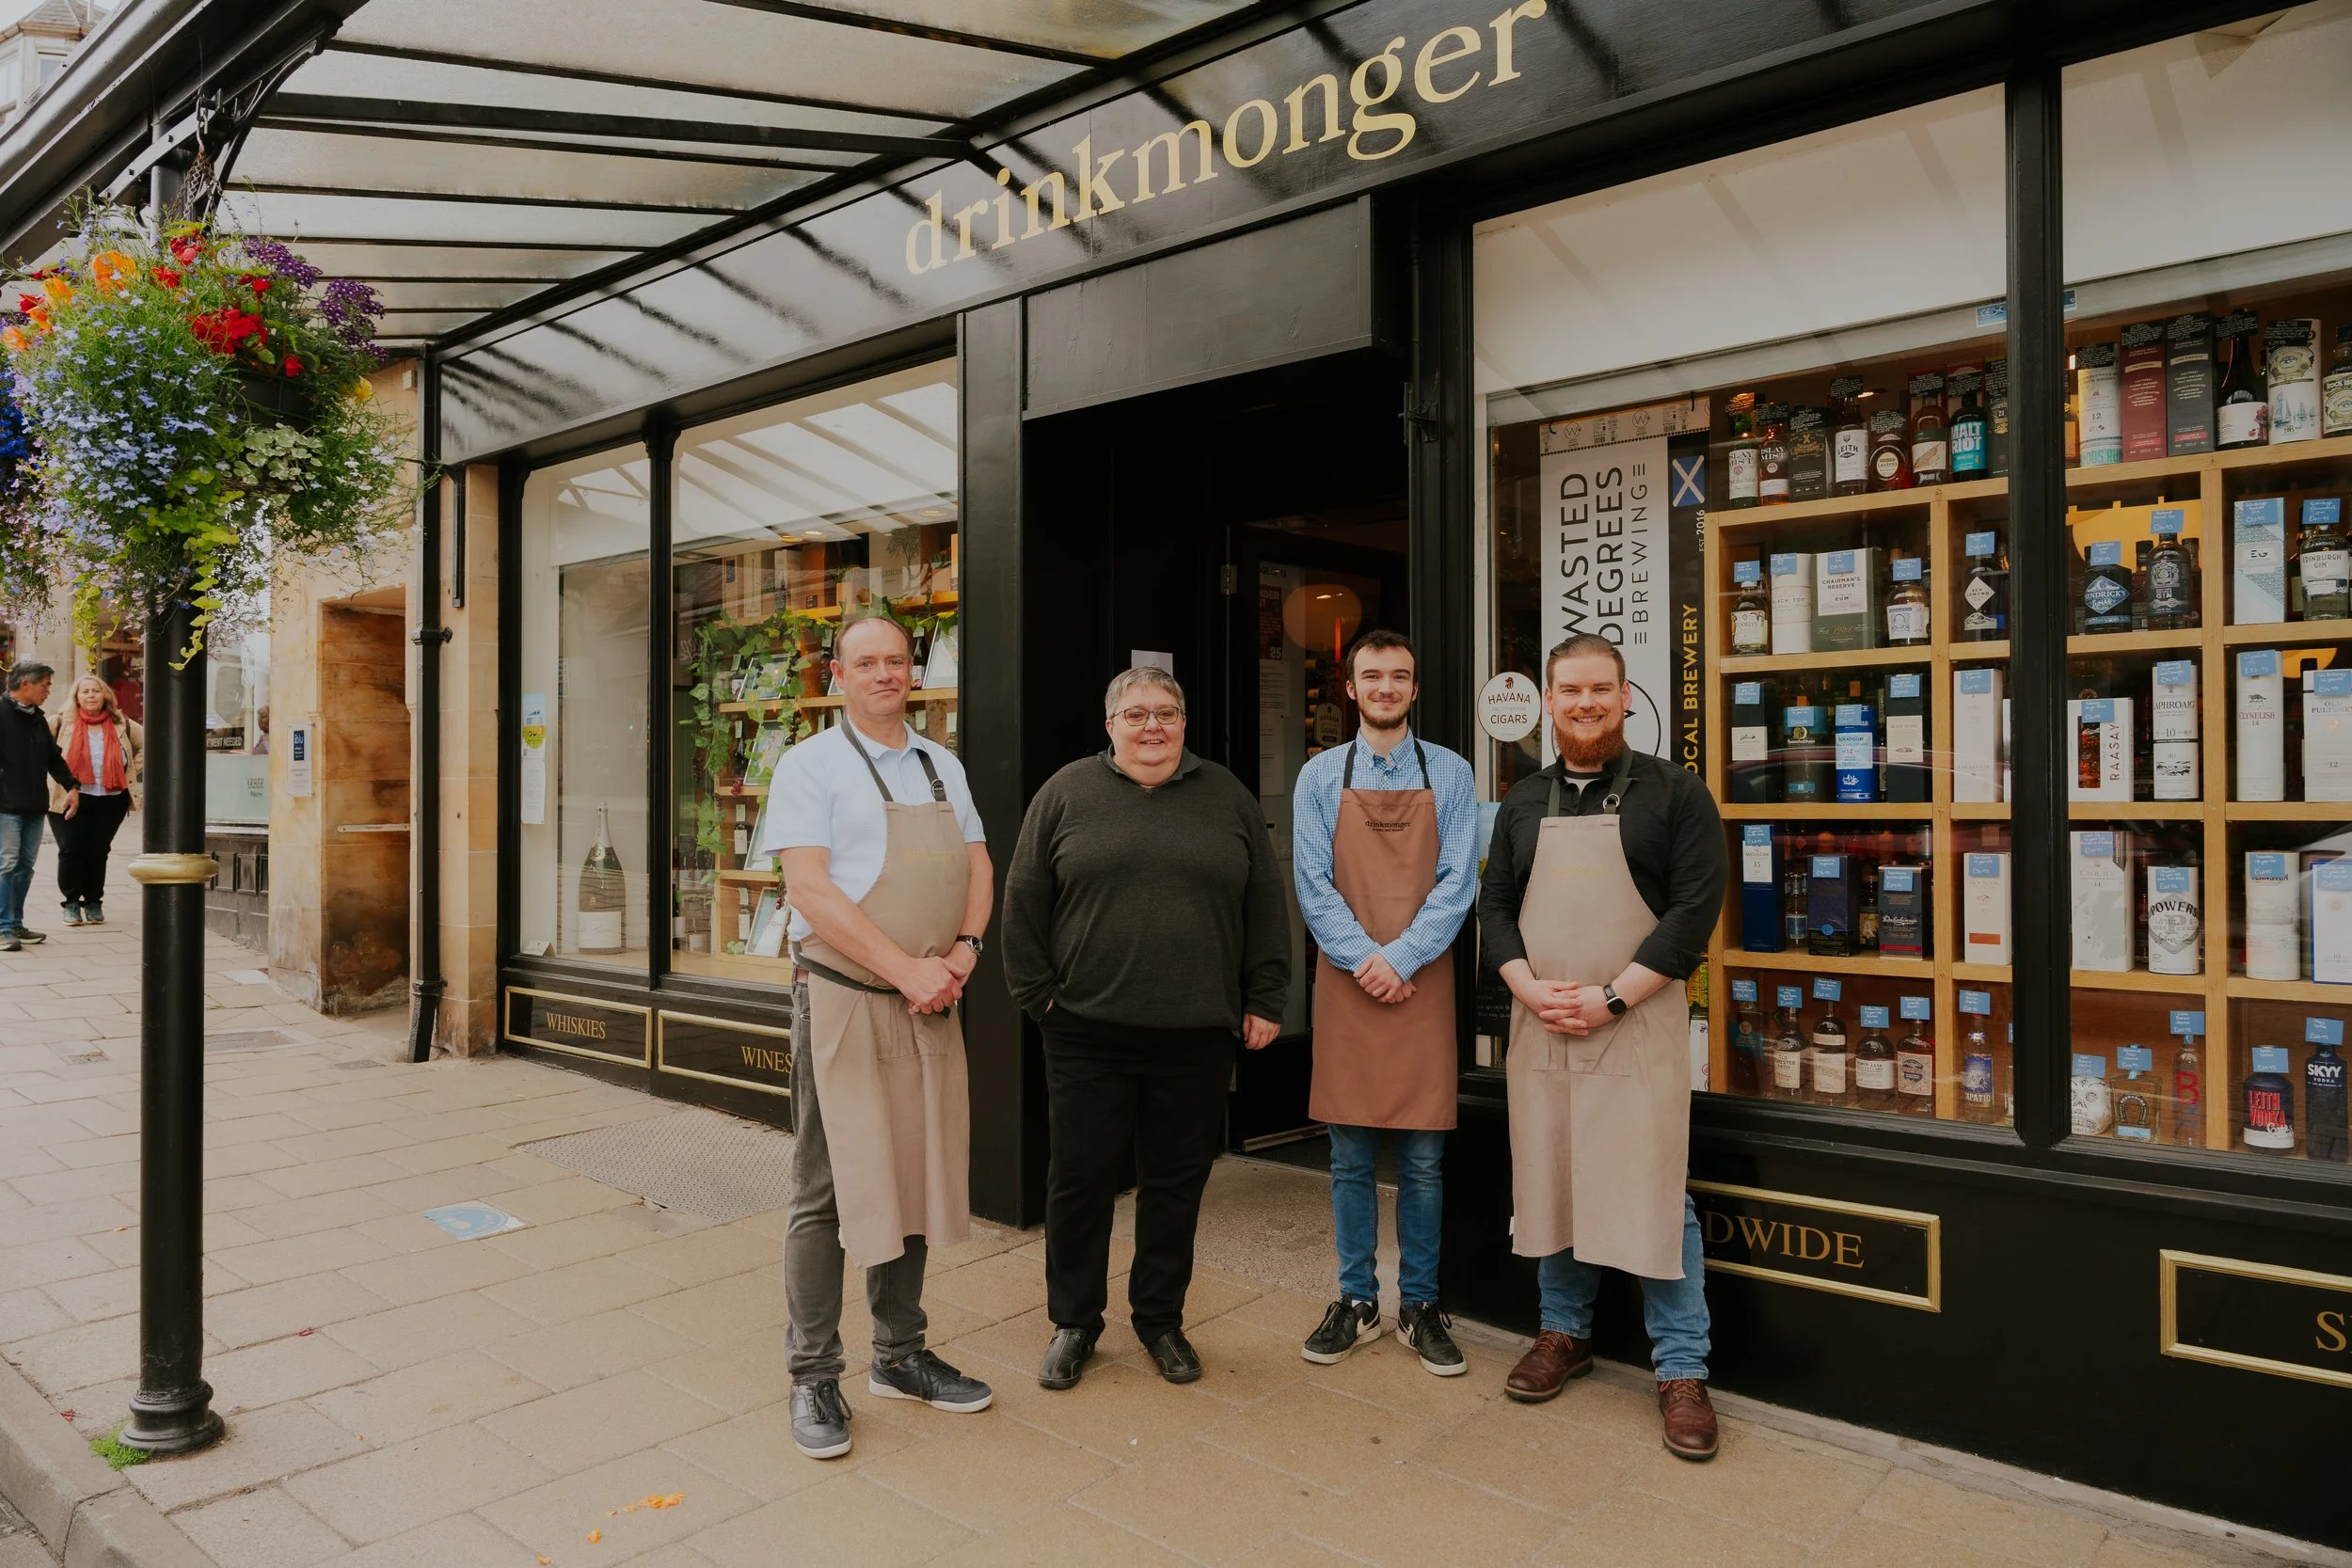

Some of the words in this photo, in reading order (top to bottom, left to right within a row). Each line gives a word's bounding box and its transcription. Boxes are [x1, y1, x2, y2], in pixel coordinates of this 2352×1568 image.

[905, 0, 1548, 276] drinkmonger
[1760, 447, 1785, 455] ISLAY
[1837, 444, 1859, 454] LEITH
[1952, 436, 1983, 454] RIOT
[1760, 452, 1786, 461] MIST
[1696, 510, 1705, 535] 2016
[1560, 473, 1589, 637] WASTED
[1596, 467, 1624, 647] DEGREES
[1630, 484, 1648, 623] BREWING
[2250, 549, 2268, 558] EG
[2302, 554, 2342, 563] EDINBURGH
[1821, 576, 1861, 585] CHAIRMAN'S
[1683, 604, 1698, 709] BREWERY
[1487, 692, 1532, 705] HAVANA
[2154, 701, 2195, 710] APHROAIG
[1490, 714, 1528, 724] CIGARS
[2238, 711, 2275, 720] CLYNELISH
[2165, 727, 2176, 737] 10
[223, 736, 242, 747] NEEDED
[2109, 723, 2120, 781] RAASAY
[1365, 820, 1411, 829] drinkmonger
[2150, 900, 2199, 917] POWERS
[546, 1012, 606, 1039] WHISKIES
[740, 1045, 792, 1074] WINES
[2307, 1063, 2342, 1078] SKYY
[2175, 1070, 2200, 1105] 8
[1964, 1092, 1991, 1101] APATIO
[2248, 1089, 2280, 1110] LEITH
[2249, 1107, 2286, 1128] VODKA
[1703, 1209, 1865, 1268] DWIDE
